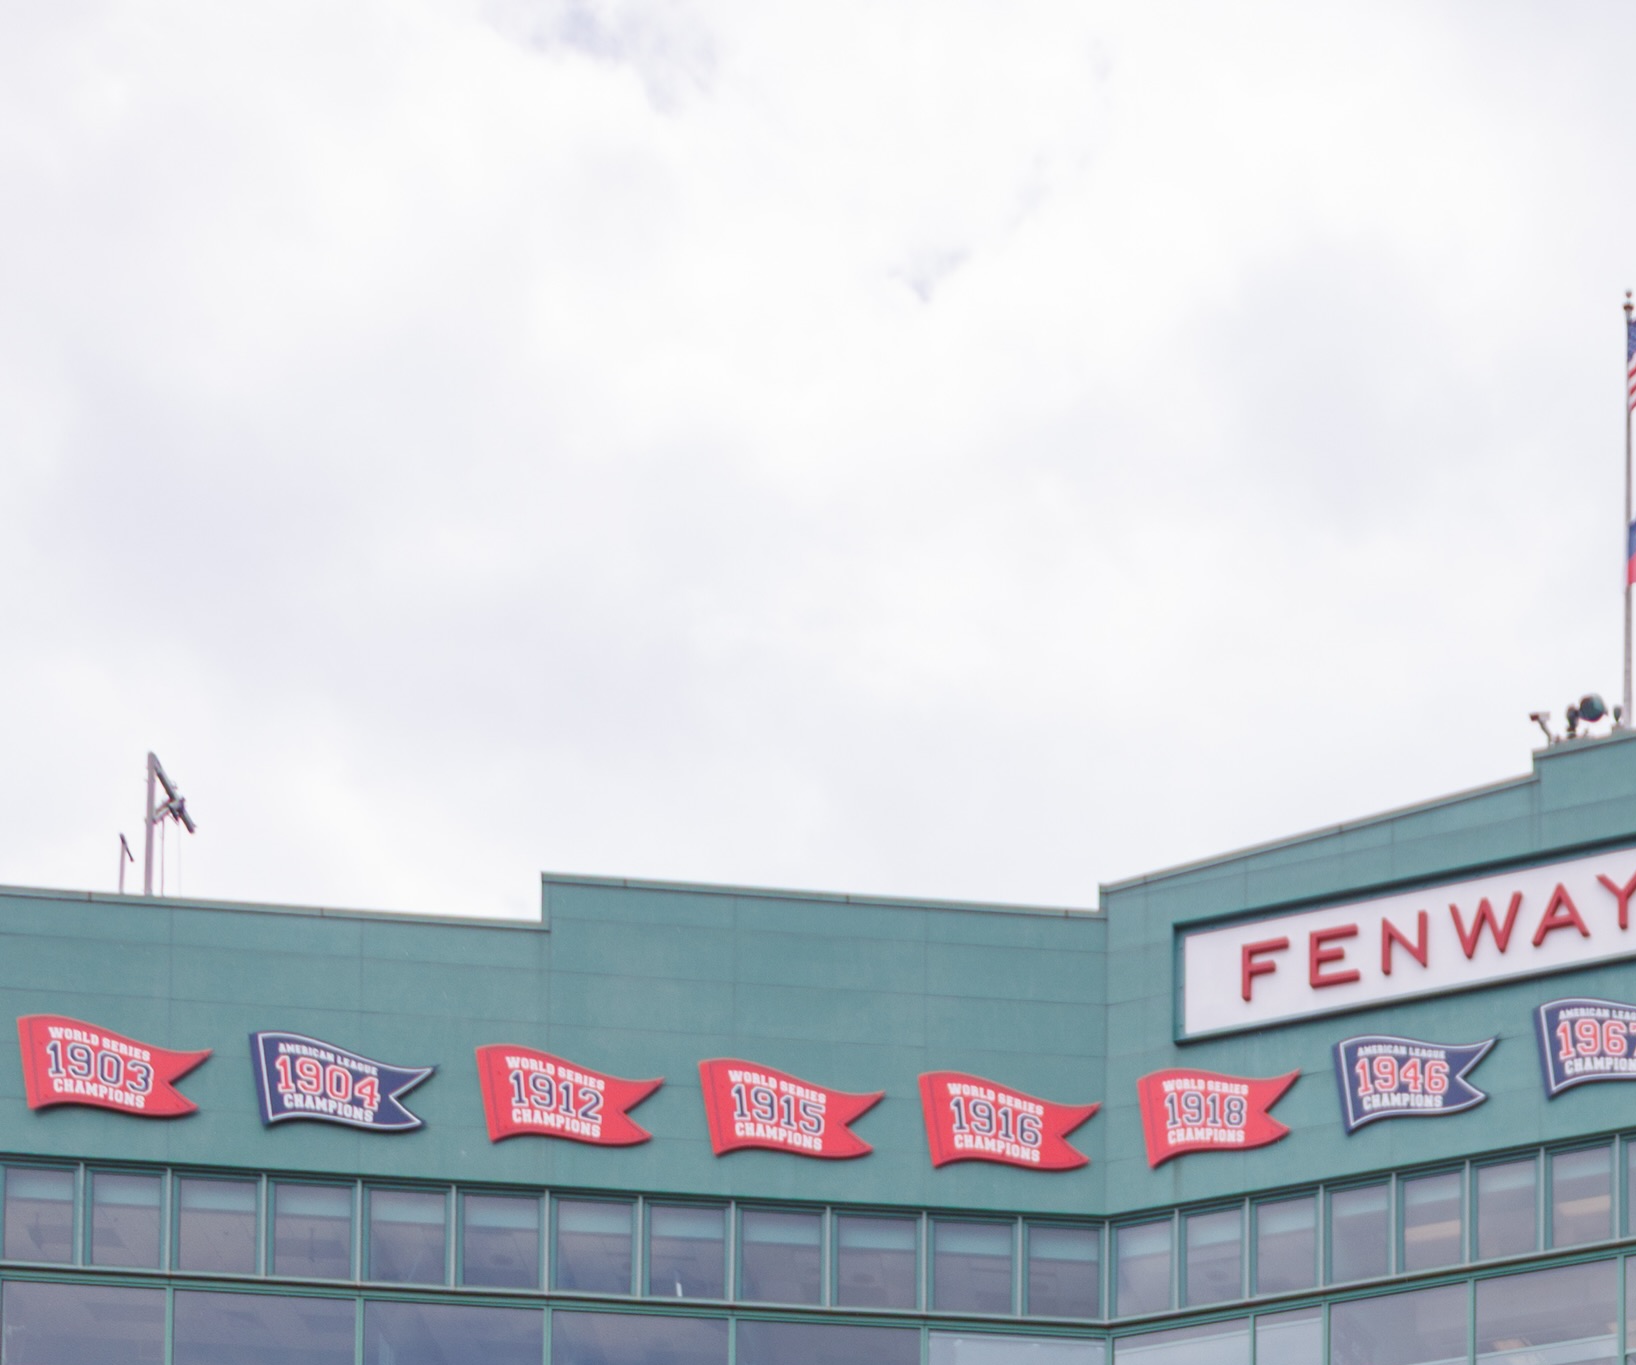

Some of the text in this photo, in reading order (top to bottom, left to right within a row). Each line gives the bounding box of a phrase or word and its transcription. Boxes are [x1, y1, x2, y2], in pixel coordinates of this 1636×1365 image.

[1556, 1006, 1609, 1021] AMERICAN
[48, 1026, 151, 1062] WORLD SERIES
[278, 1042, 378, 1076] AMERICAN LEAGUE
[1355, 1043, 1447, 1060] AMERICAN LEAGUE
[46, 1040, 154, 1095] 1903
[276, 1054, 380, 1111] 1904
[505, 1055, 605, 1092] WORLD SERIES
[1354, 1058, 1449, 1096] 1946
[52, 1077, 146, 1109] CHAMPIONS
[508, 1070, 604, 1124] 1912
[728, 1069, 827, 1105] WORLD SERIES
[947, 1082, 1044, 1117] WORLD SERIES
[1162, 1077, 1249, 1096] WORLD SERIES
[1360, 1092, 1443, 1112] CHAMPIONS
[282, 1093, 374, 1123] CHAMPIONS
[511, 1108, 601, 1138] CHAMPIONS
[730, 1083, 826, 1136] 1915
[949, 1096, 1043, 1149] 1916
[1164, 1092, 1248, 1129] 1918
[734, 1121, 823, 1152] CHAMPIONS
[953, 1133, 1040, 1163] CHAMPIONS
[1166, 1127, 1245, 1146] CHAMPIONS
